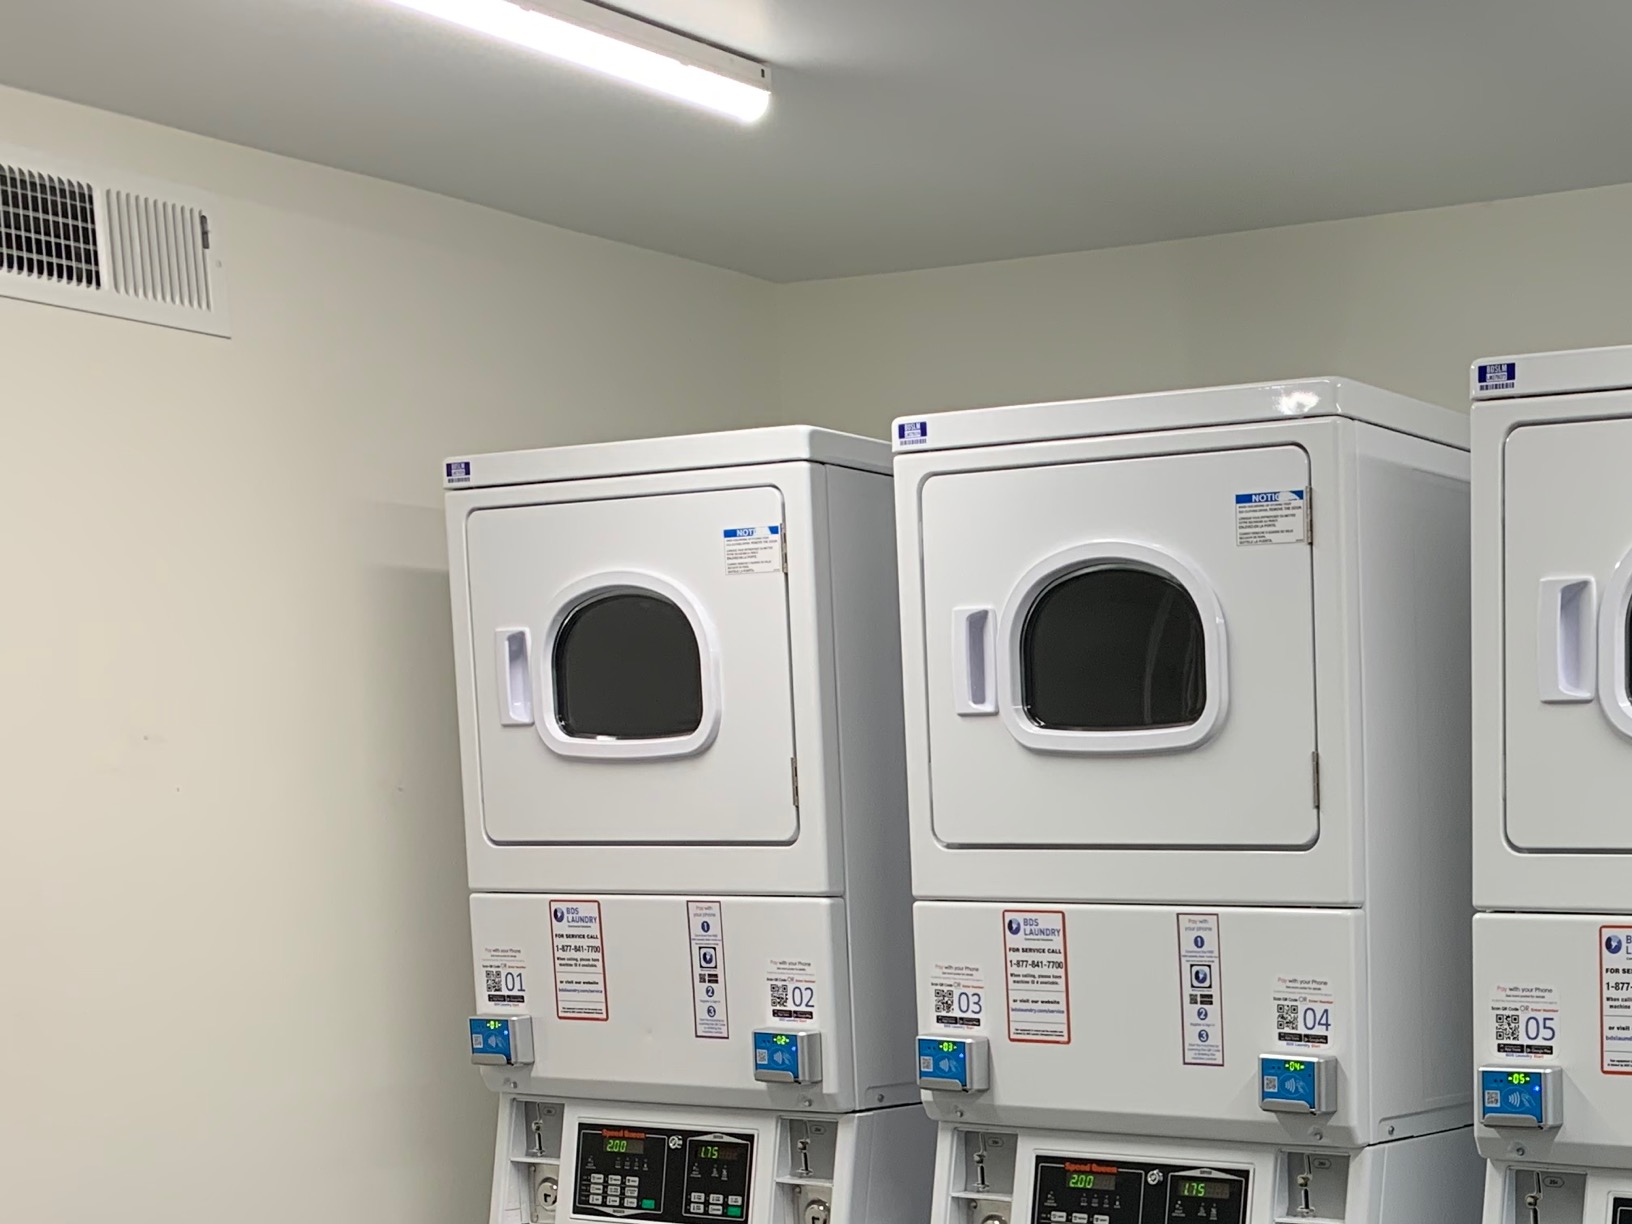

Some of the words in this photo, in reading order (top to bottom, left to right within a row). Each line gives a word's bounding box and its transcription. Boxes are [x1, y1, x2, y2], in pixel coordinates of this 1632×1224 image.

[566, 907, 579, 915] BDS
[1023, 918, 1039, 926] BDS
[1023, 928, 1061, 937] LAUNDRY
[504, 972, 526, 992] 01
[791, 986, 815, 1008] 02
[958, 992, 982, 1014] 03
[1199, 1008, 1206, 1019] 2
[1303, 1007, 1331, 1031] 04
[1525, 1016, 1556, 1041] 05
[1200, 1031, 1206, 1041] 3
[1069, 1174, 1094, 1188] 2.00
